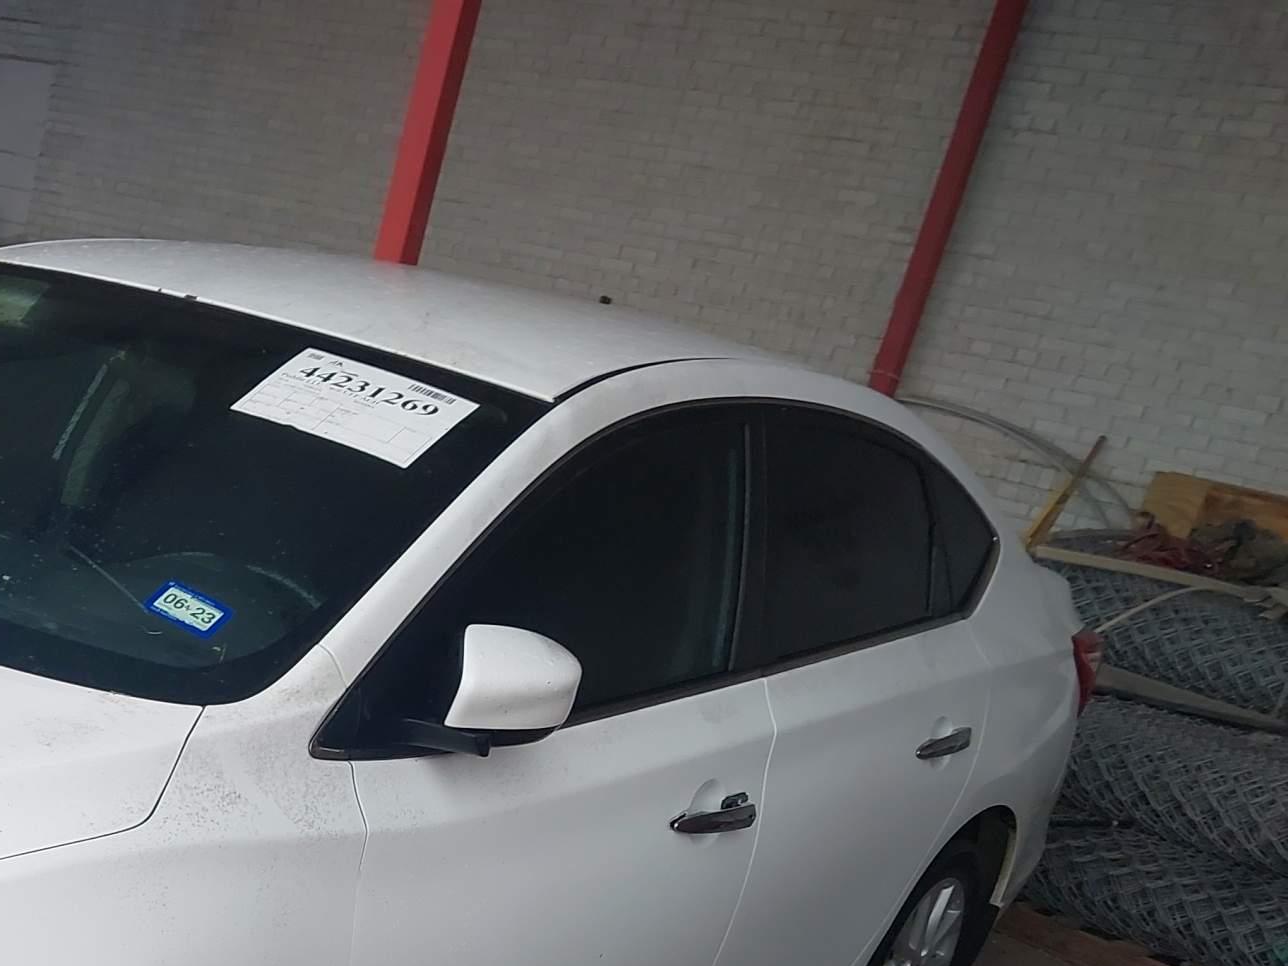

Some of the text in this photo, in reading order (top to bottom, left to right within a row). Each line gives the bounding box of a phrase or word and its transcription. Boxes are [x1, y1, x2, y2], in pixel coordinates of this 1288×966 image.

[300, 367, 439, 415] 44231269
[163, 593, 189, 609] 06
[190, 607, 217, 624] 23
